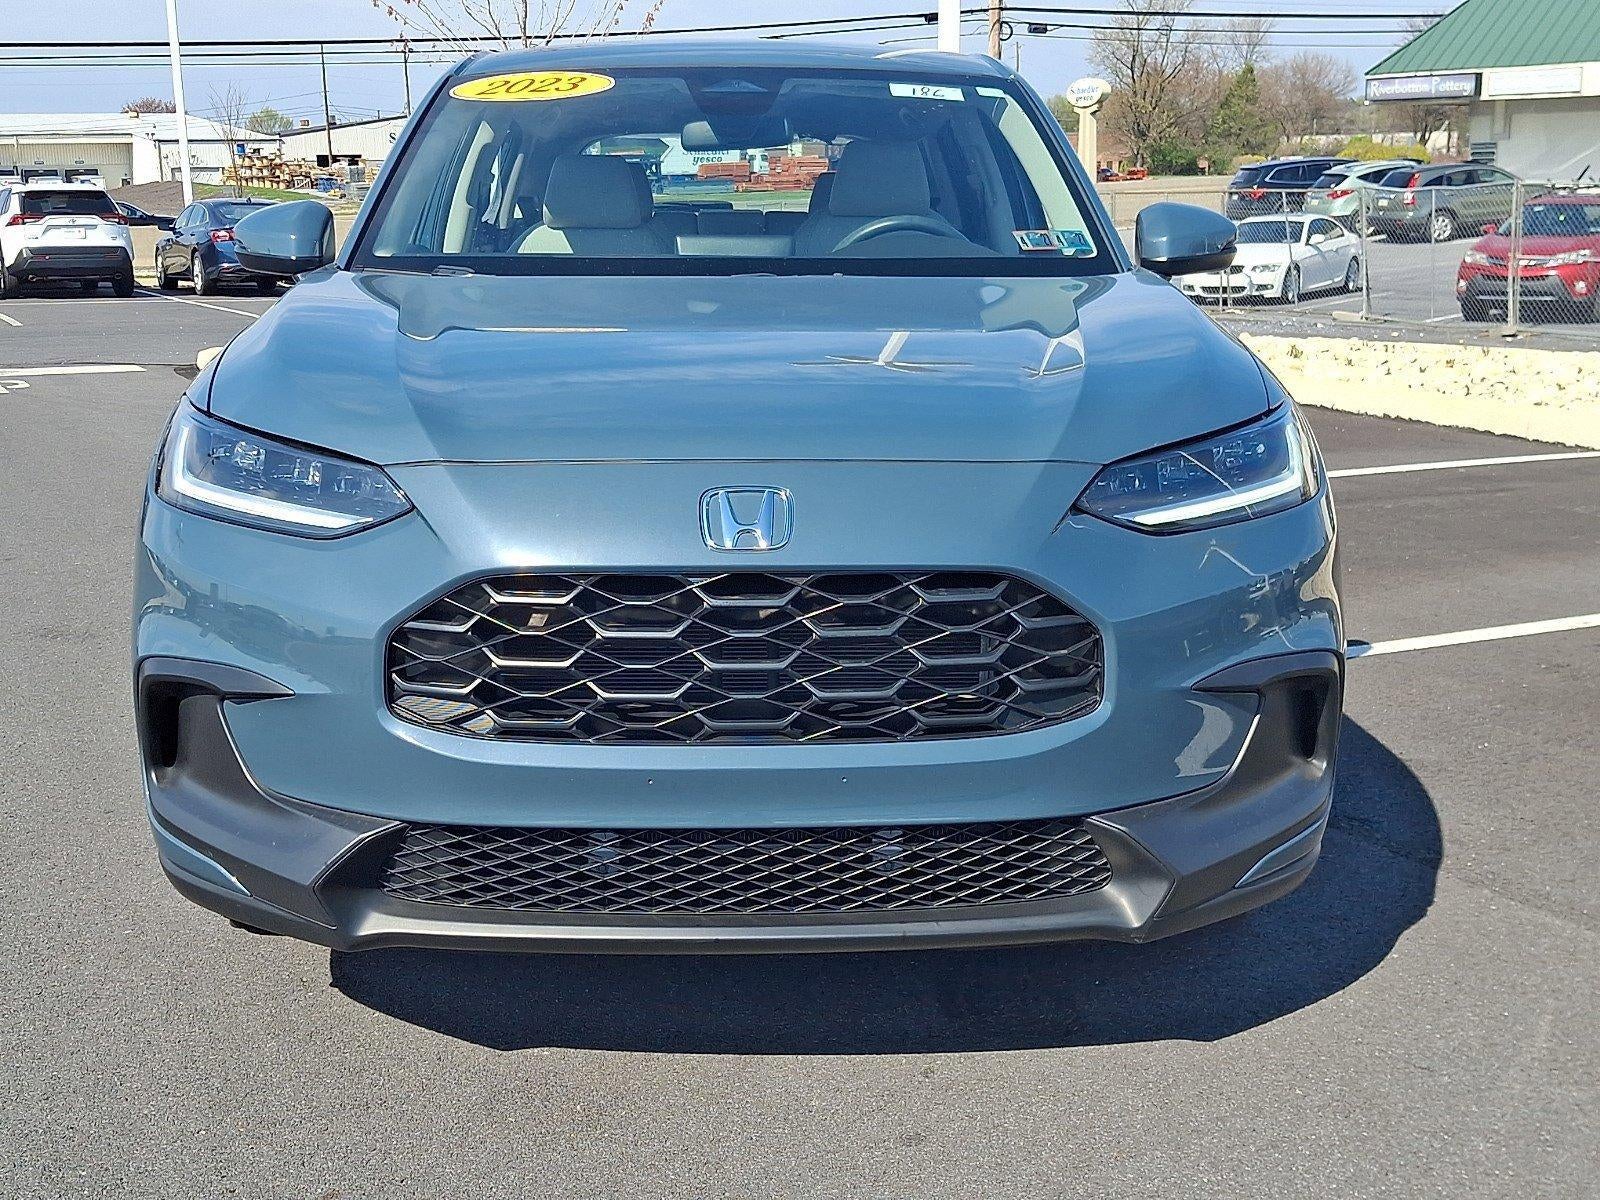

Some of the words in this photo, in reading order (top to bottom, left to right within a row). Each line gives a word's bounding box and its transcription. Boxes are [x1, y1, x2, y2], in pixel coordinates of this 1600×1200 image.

[475, 76, 587, 96] 2023
[1431, 76, 1472, 96] Pottery
[692, 156, 723, 167] yesco
